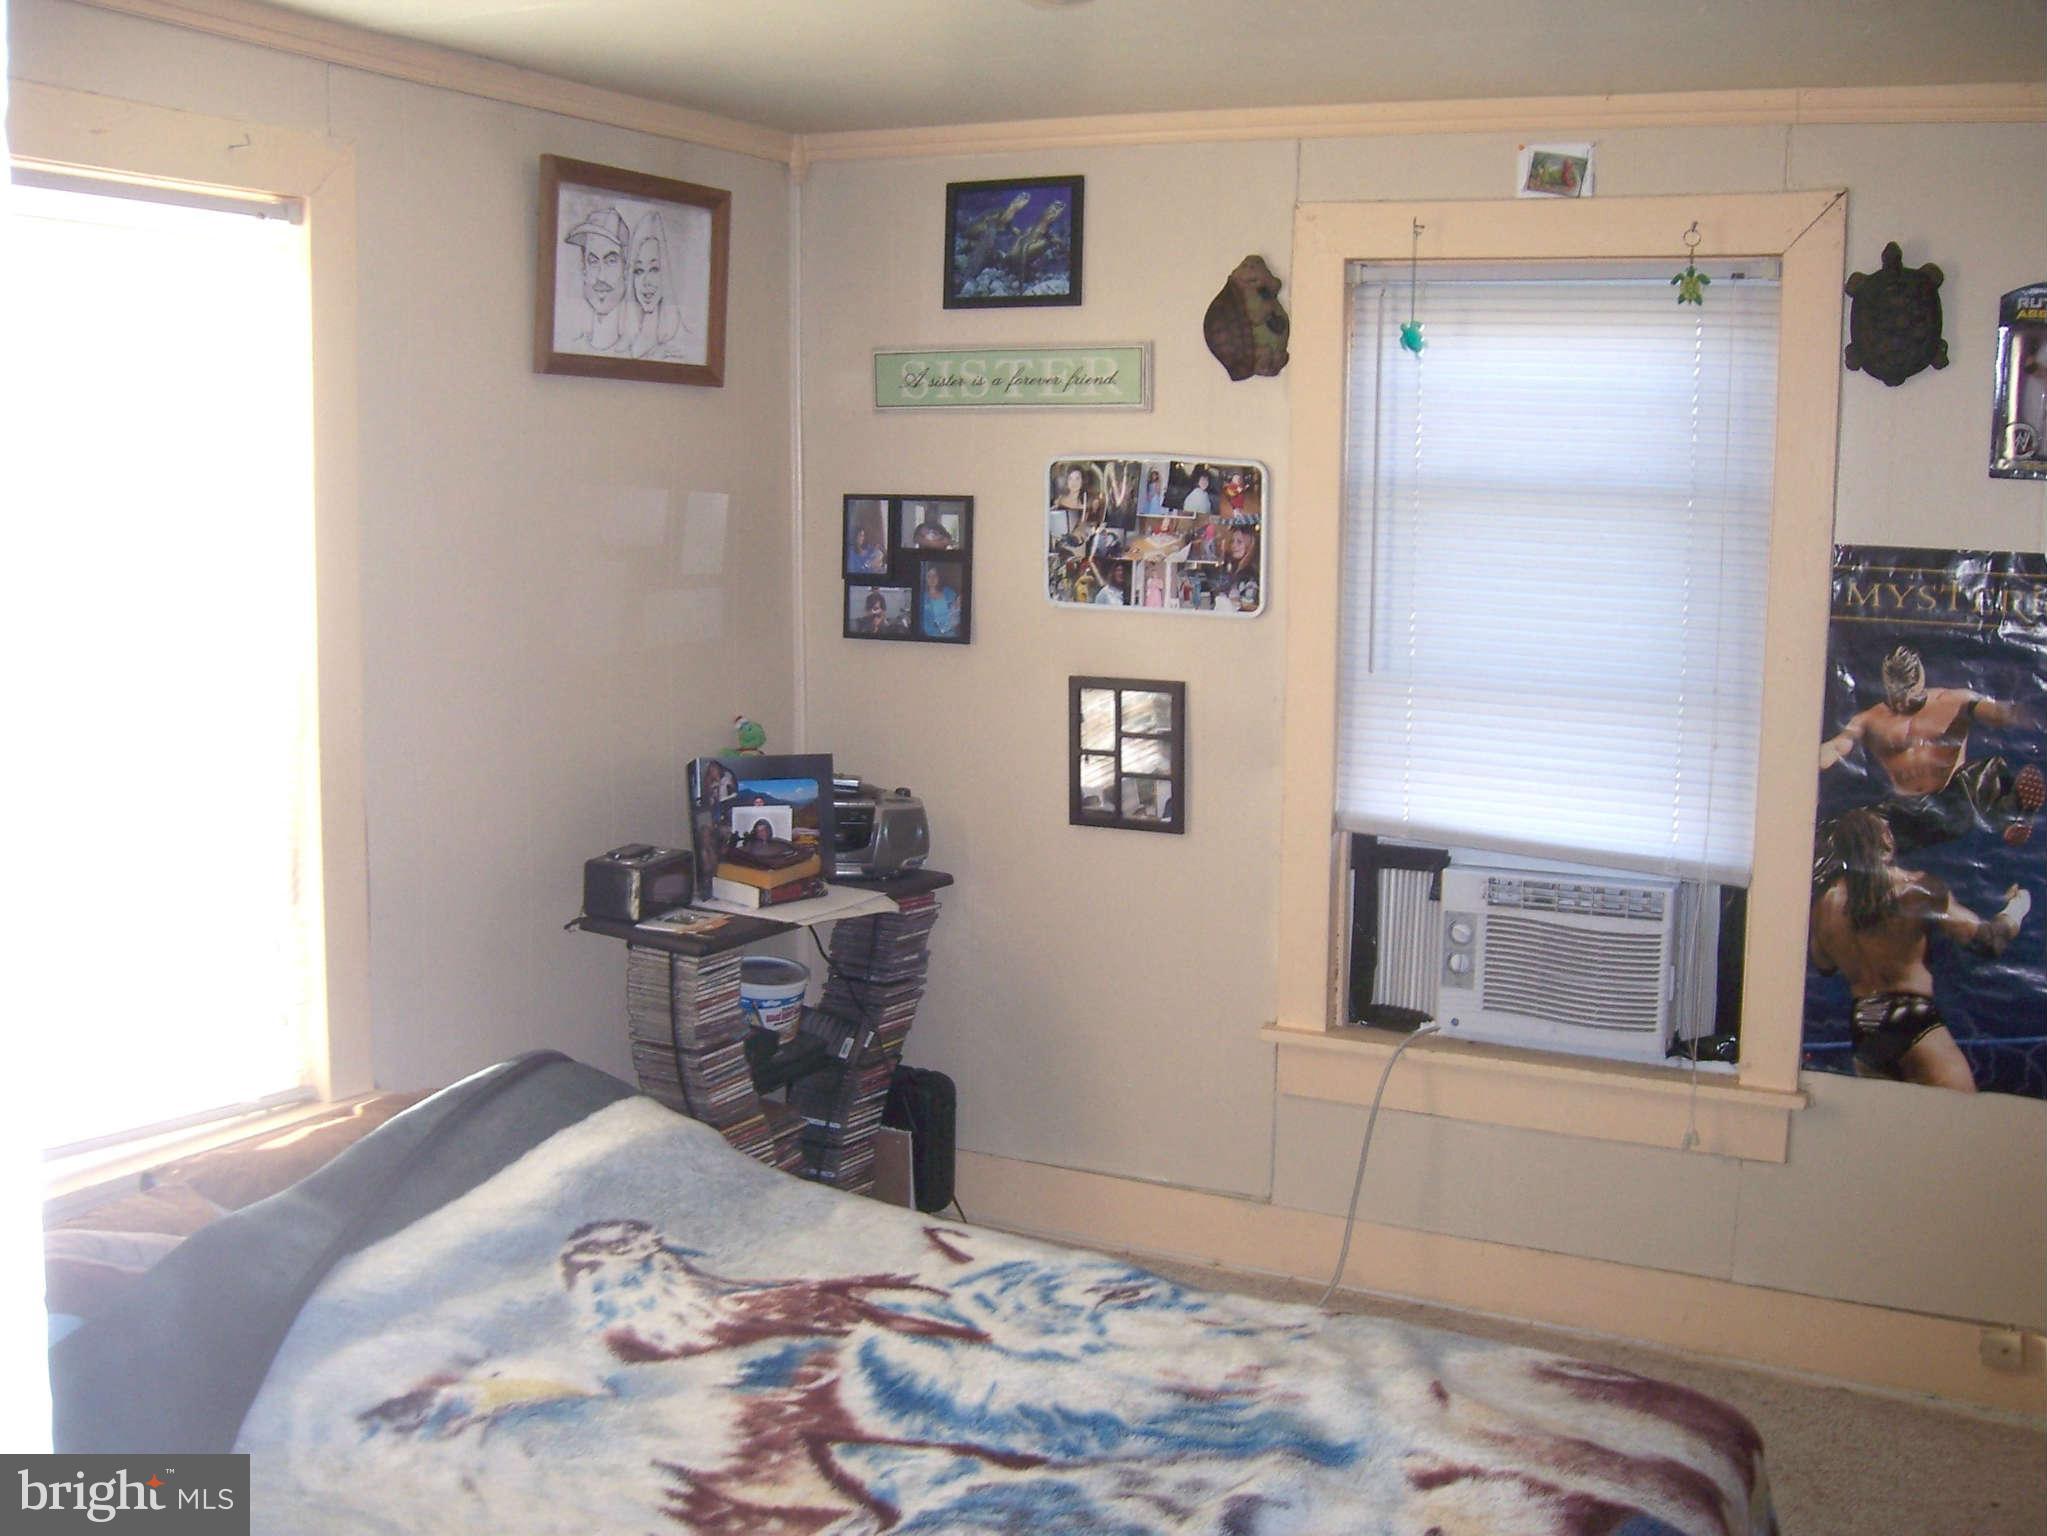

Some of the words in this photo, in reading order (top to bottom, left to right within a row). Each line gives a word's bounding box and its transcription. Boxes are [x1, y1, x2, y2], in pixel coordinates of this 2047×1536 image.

[900, 367, 930, 388] A
[928, 374, 965, 387] sister
[971, 375, 986, 386] is
[991, 377, 1002, 386] a
[1004, 366, 1062, 392] forever
[902, 357, 1122, 399] SISTER
